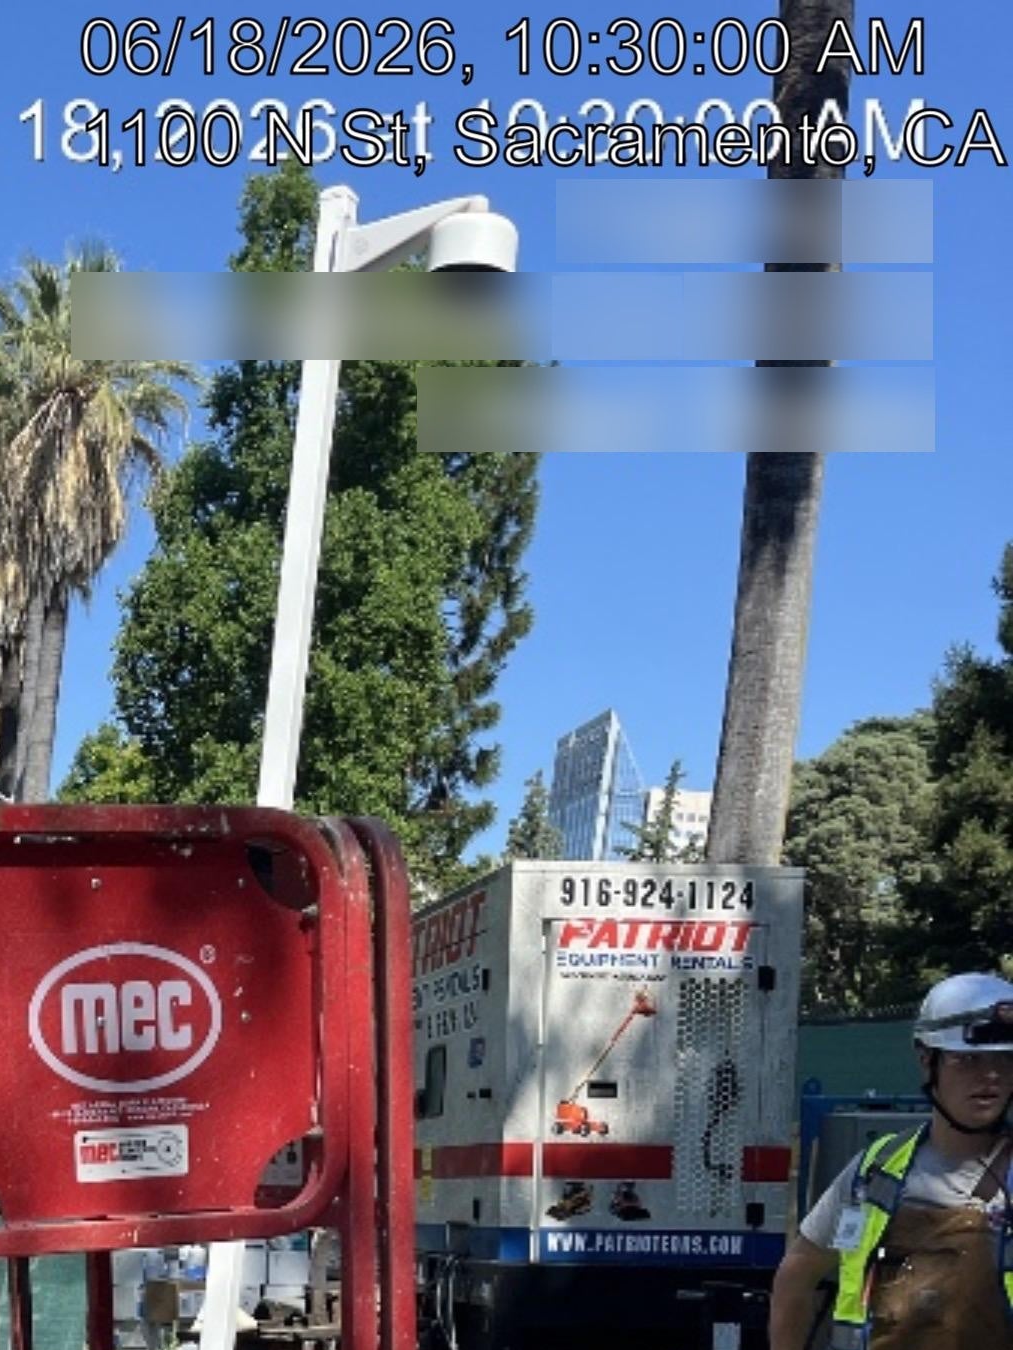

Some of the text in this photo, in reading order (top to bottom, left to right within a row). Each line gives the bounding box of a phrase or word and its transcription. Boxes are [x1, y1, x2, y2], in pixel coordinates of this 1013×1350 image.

[560, 877, 754, 910] 916-924-1124
[558, 918, 757, 952] PATRIOT
[556, 951, 754, 970] EQUIPMENT RENTALS
